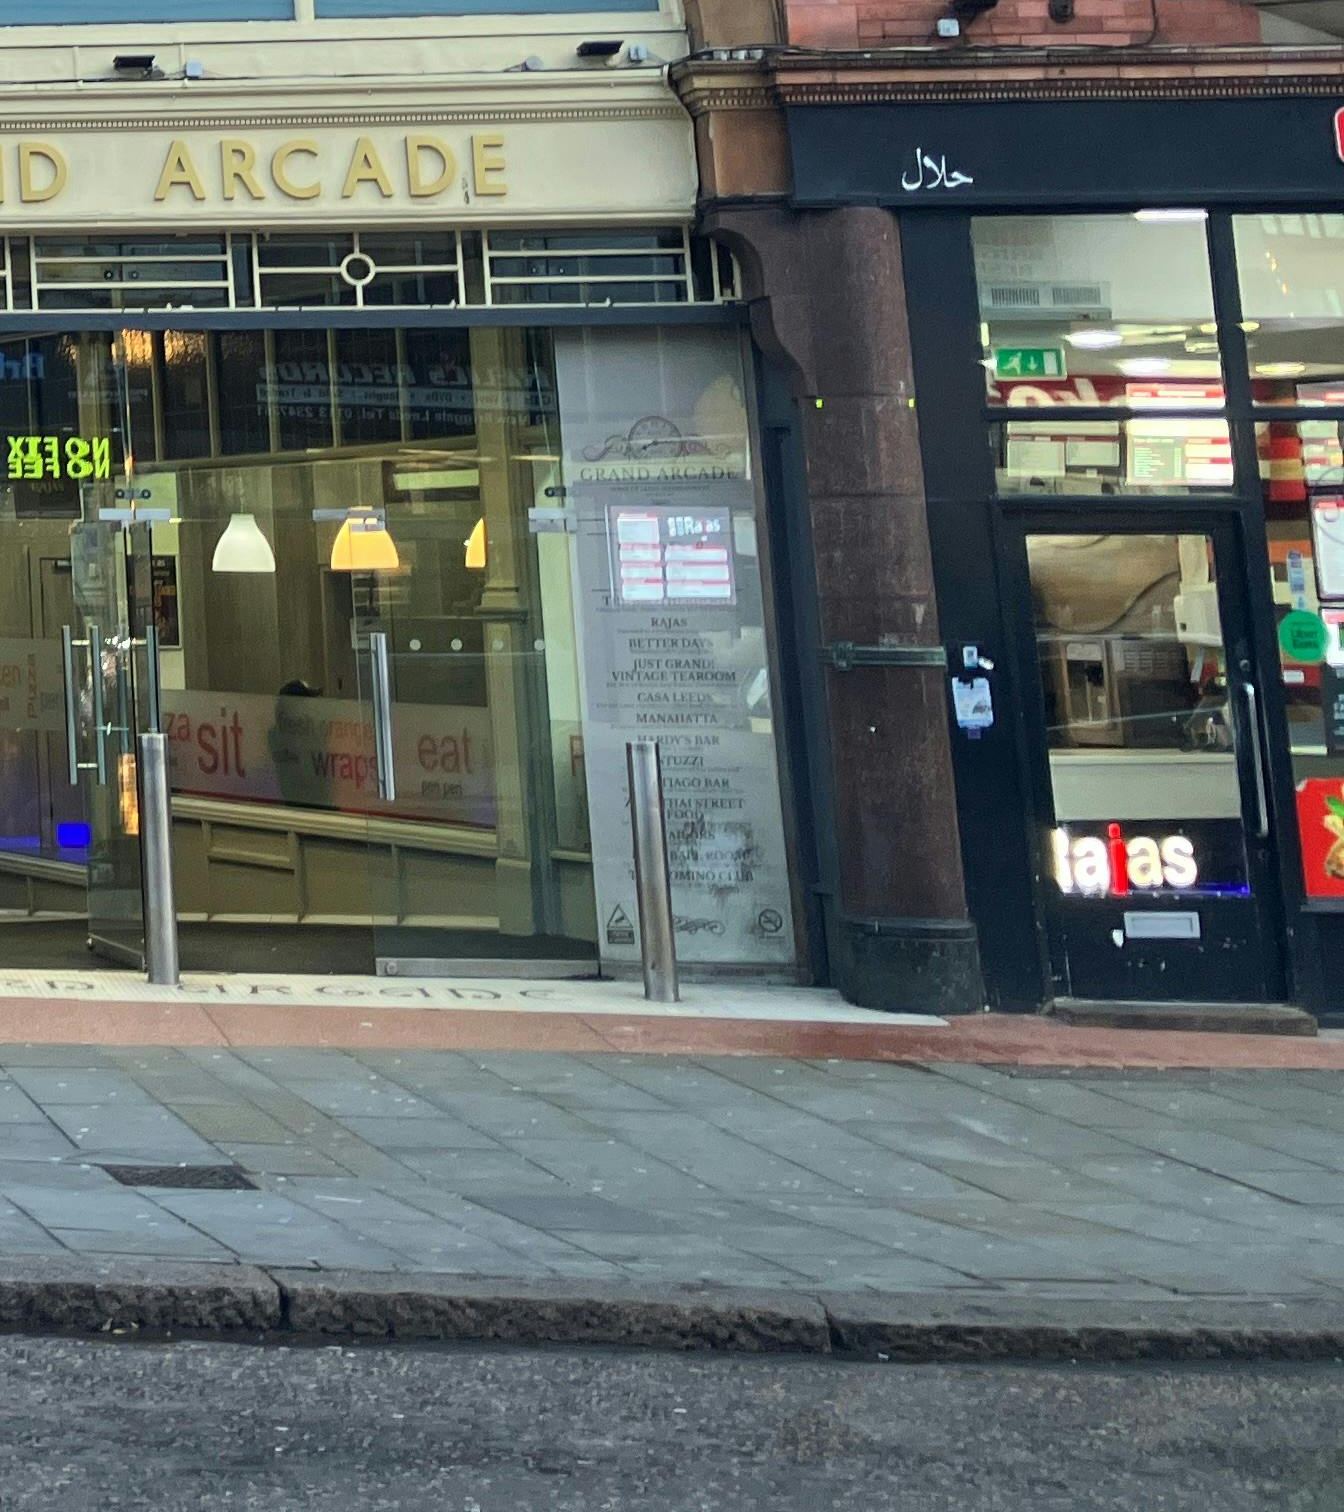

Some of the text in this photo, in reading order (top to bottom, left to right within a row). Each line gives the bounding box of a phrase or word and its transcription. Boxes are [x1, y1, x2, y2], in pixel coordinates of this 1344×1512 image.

[153, 134, 508, 202] ARCADE
[902, 146, 973, 191] حلال
[580, 465, 738, 481] GRAND ARCADE
[651, 617, 688, 629] RAJAS
[629, 638, 714, 649] BETTER DAYS
[633, 658, 662, 671] JUST
[612, 671, 736, 682] VINTAGE TEAROOM
[637, 692, 712, 703] CASA LEEDS
[636, 713, 719, 724] MANAHATTA
[197, 707, 246, 779] sit
[696, 735, 720, 746] BAR
[417, 726, 475, 775] eat
[311, 750, 379, 786] wraps
[704, 778, 730, 788] BAR
[695, 798, 745, 809] STREET
